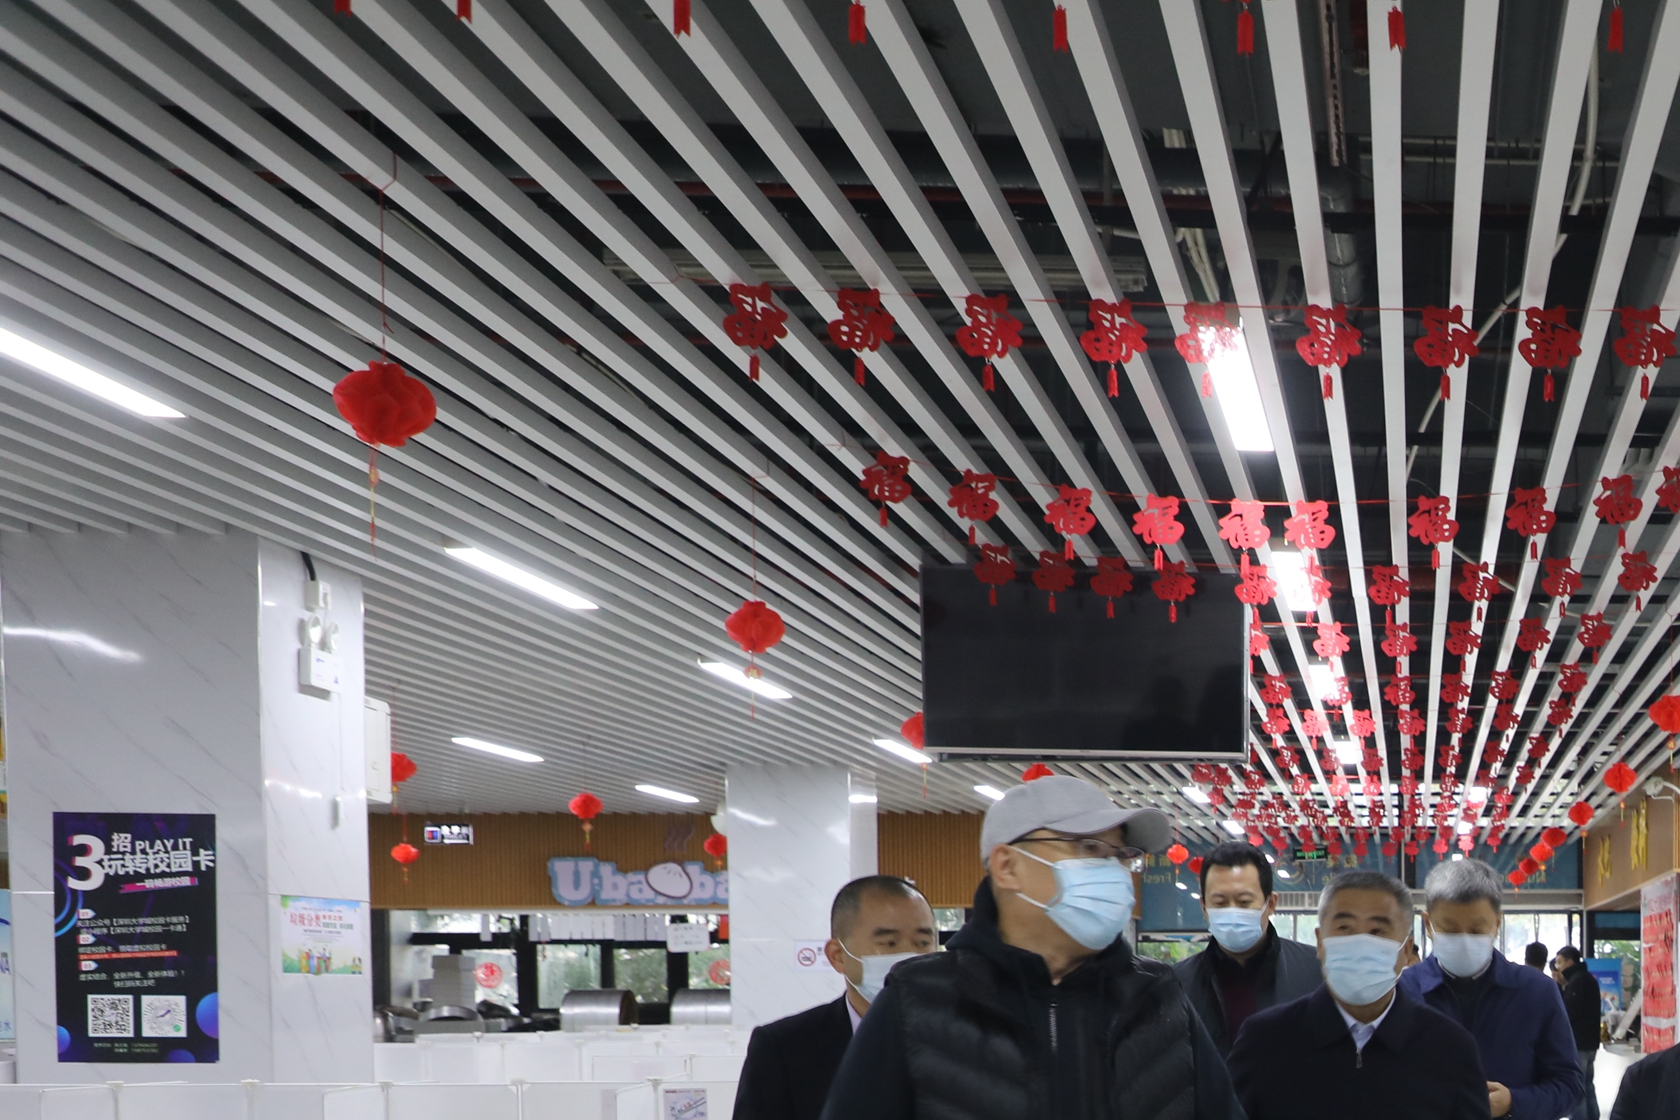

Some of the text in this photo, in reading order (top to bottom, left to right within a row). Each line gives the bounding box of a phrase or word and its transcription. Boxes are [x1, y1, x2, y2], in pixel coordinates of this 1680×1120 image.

[135, 838, 193, 852] PLAY IT
[67, 832, 132, 891] 3 招
[101, 848, 215, 876] 玩转校园卡
